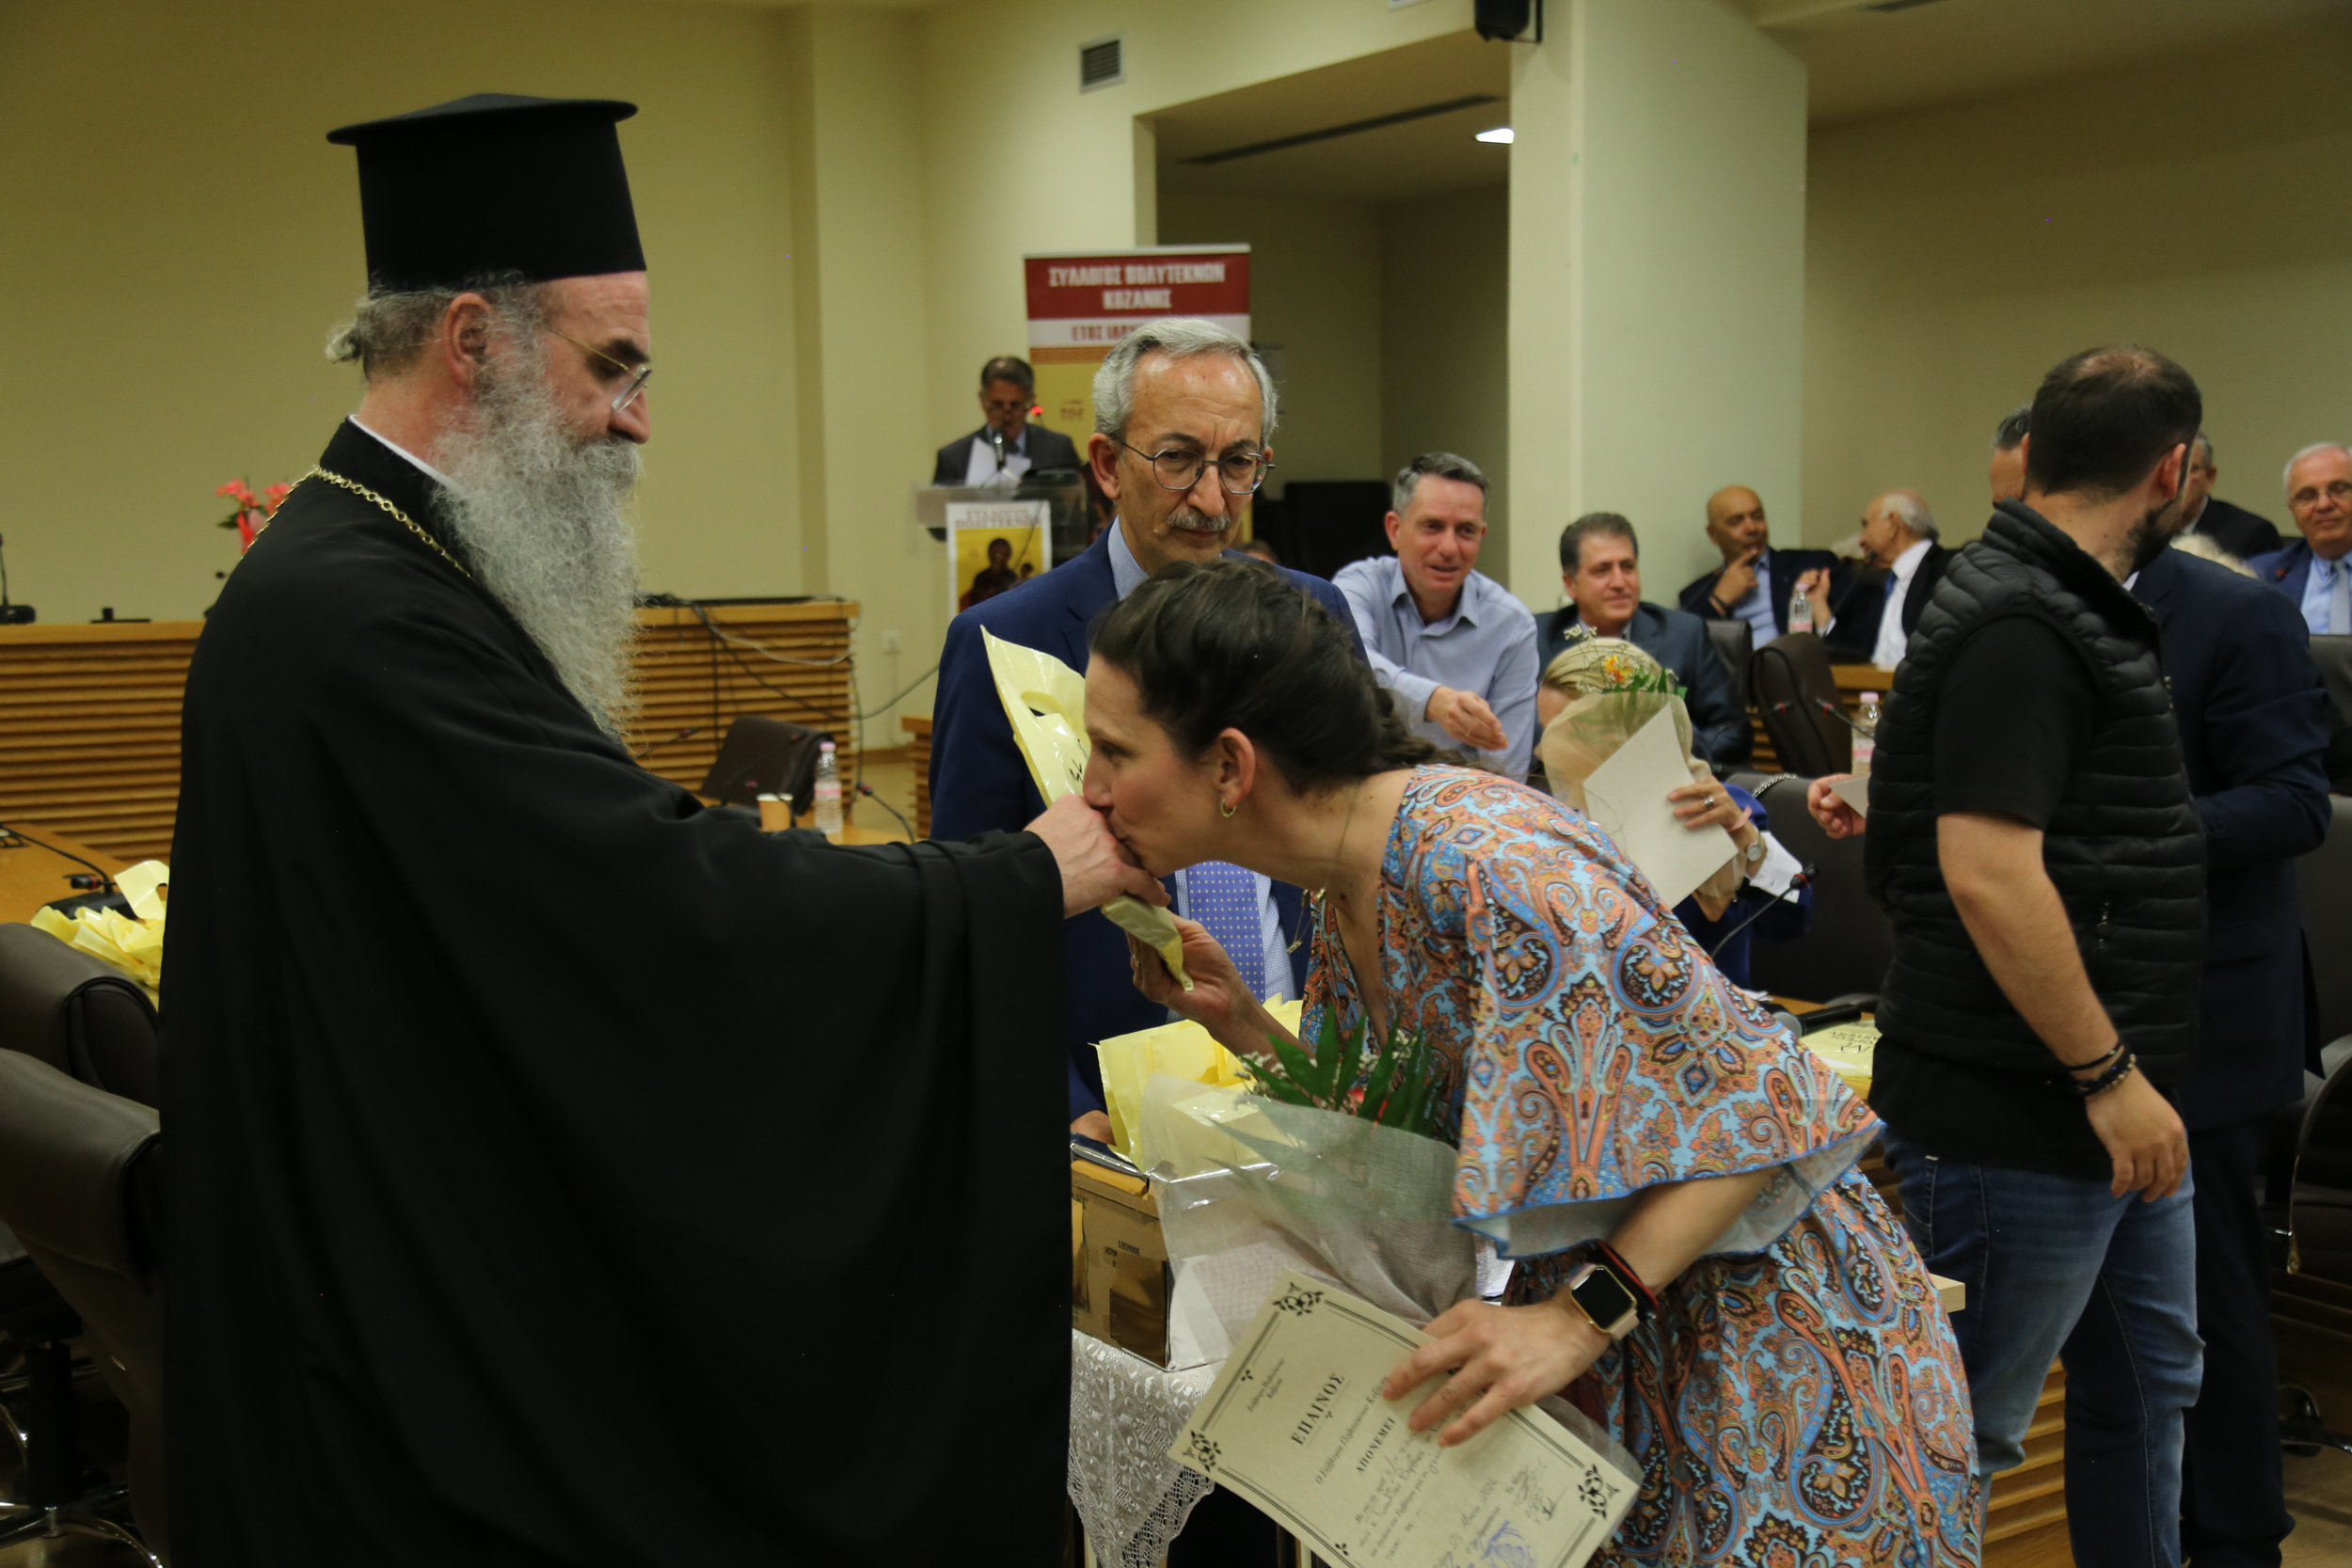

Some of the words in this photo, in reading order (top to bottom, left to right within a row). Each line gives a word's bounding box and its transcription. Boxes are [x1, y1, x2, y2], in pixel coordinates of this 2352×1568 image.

[1103, 289, 1172, 310] ΚΟΖΑΝΗΣ
[1290, 1370, 1345, 1445] ΕΠΑΙΝΟΣ
[1339, 1402, 1371, 1446] Πολυτέκνων
[1318, 1444, 1346, 1479] Σύλλογος
[1354, 1416, 1396, 1474] ΑΠΟΝΕΜΕΙ
[1313, 1475, 1324, 1484] Ο
